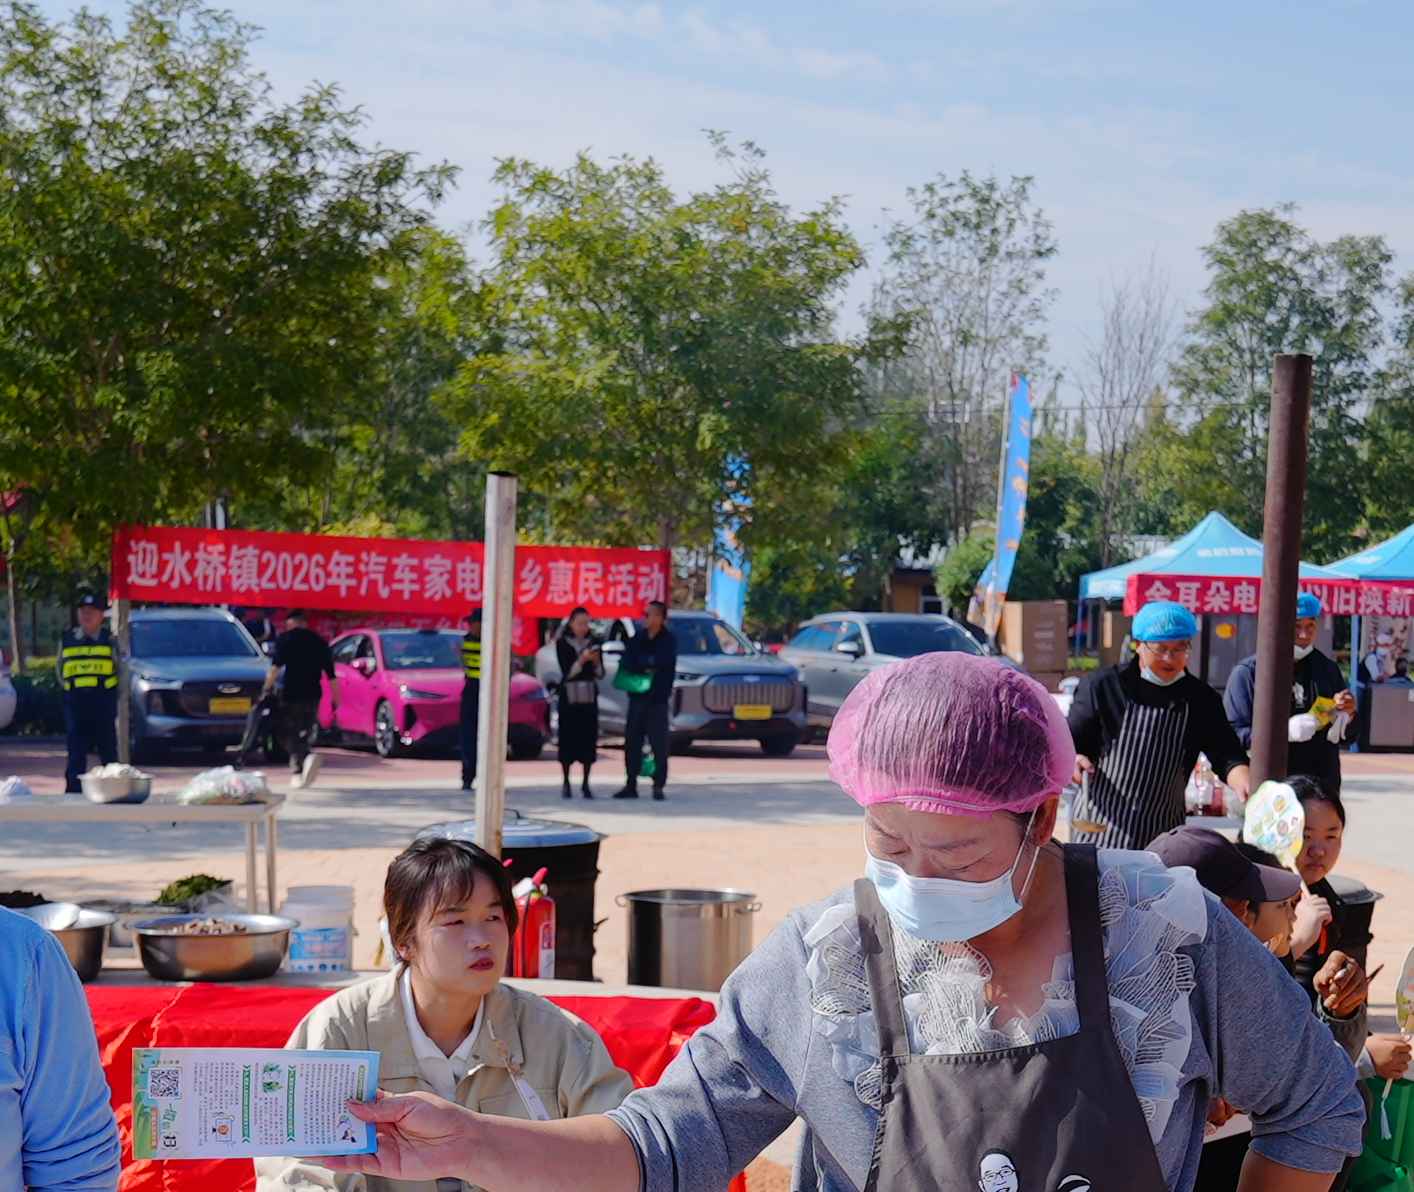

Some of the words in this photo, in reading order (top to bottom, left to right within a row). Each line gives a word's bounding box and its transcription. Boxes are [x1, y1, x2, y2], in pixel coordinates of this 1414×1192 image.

[127, 540, 666, 607] 迎水桥镇2026年汽车家电乡惠民活动
